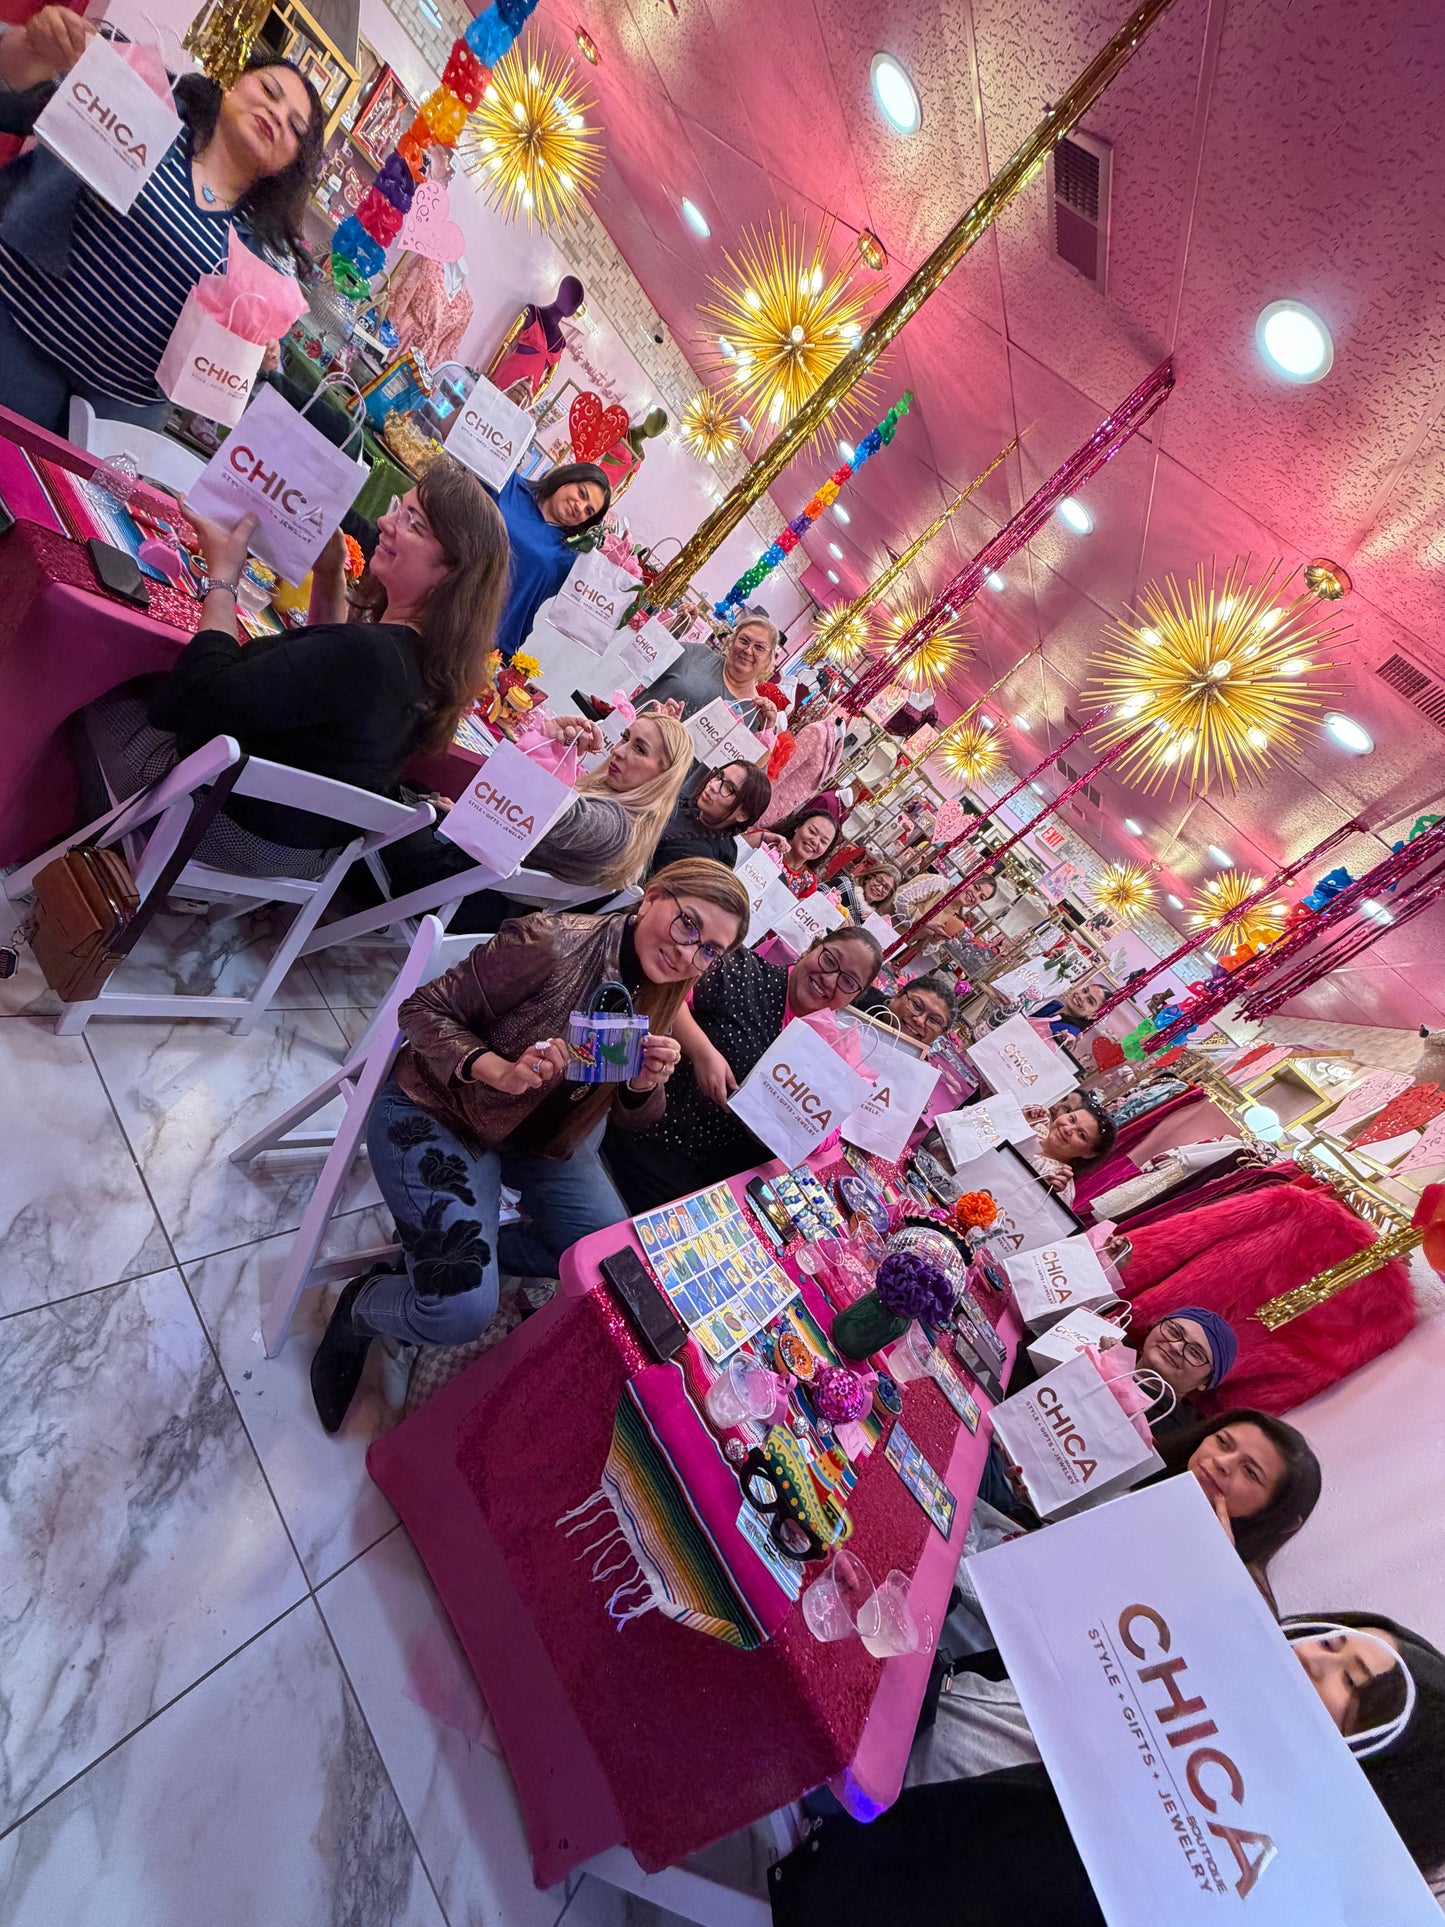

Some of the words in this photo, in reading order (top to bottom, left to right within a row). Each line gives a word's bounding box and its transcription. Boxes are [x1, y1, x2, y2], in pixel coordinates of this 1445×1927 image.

[72, 82, 146, 167] CHICA
[194, 356, 249, 393] CHICA
[465, 410, 513, 457] CHICA
[230, 445, 323, 535] CHICA
[574, 579, 615, 616] CHICA
[635, 634, 658, 661] CHICA
[474, 781, 535, 835] CHICA
[1041, 825, 1065, 848] EXIT
[745, 863, 767, 889] CHICA
[795, 907, 825, 937] CHICA
[762, 1080, 777, 1097] STYLE
[1004, 1043, 1039, 1086] CHICA
[772, 1063, 832, 1131] CHICA
[1042, 1251, 1073, 1304] CHICA
[1025, 1401, 1039, 1422] STYLE
[1040, 1426, 1054, 1448] GIFTS
[1054, 1452, 1076, 1485] JEWELRY
[1036, 1387, 1098, 1484] CHICA
[1088, 1627, 1121, 1687] STYLE
[1123, 1705, 1156, 1767] GIFTS
[1158, 1788, 1213, 1893] JEWELRY
[1118, 1603, 1278, 1901] CHICA
[1186, 1815, 1228, 1895] BOUTIQUE
